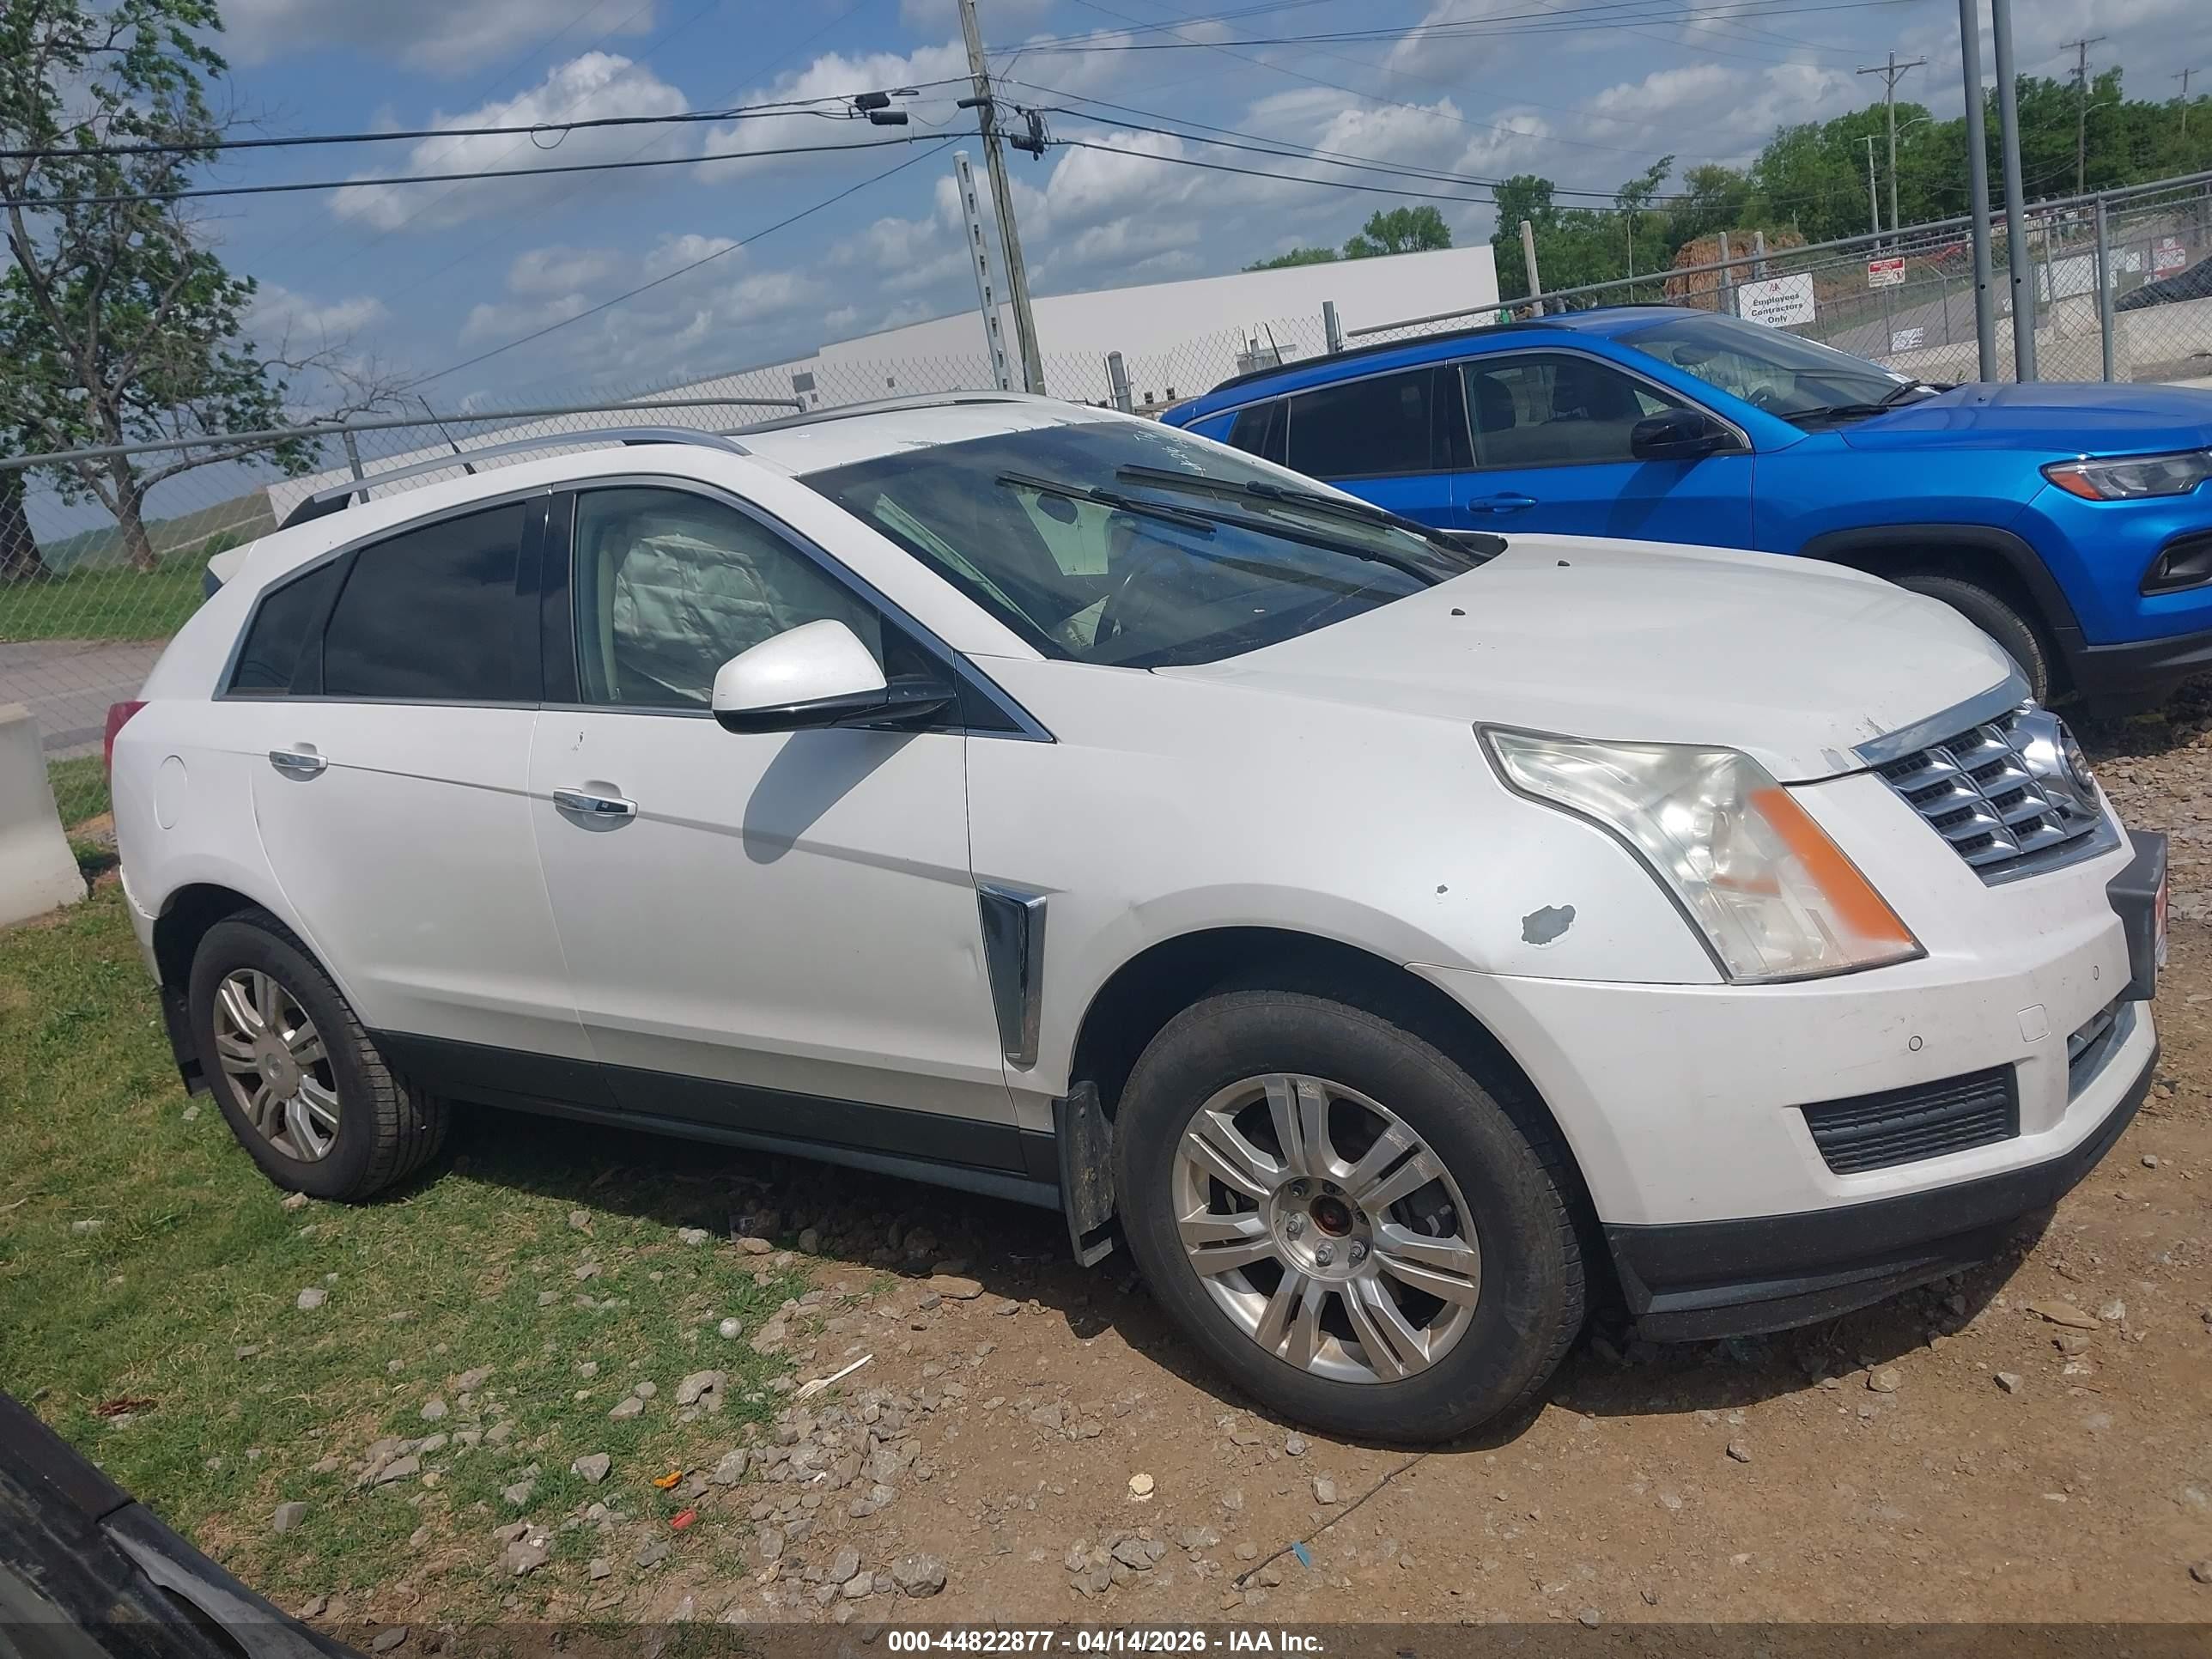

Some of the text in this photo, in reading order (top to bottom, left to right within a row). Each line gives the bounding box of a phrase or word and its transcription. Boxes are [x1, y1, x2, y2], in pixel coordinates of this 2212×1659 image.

[1753, 293, 1800, 306] Employees
[1752, 302, 1803, 316] Contractors
[1767, 315, 1788, 324] Only
